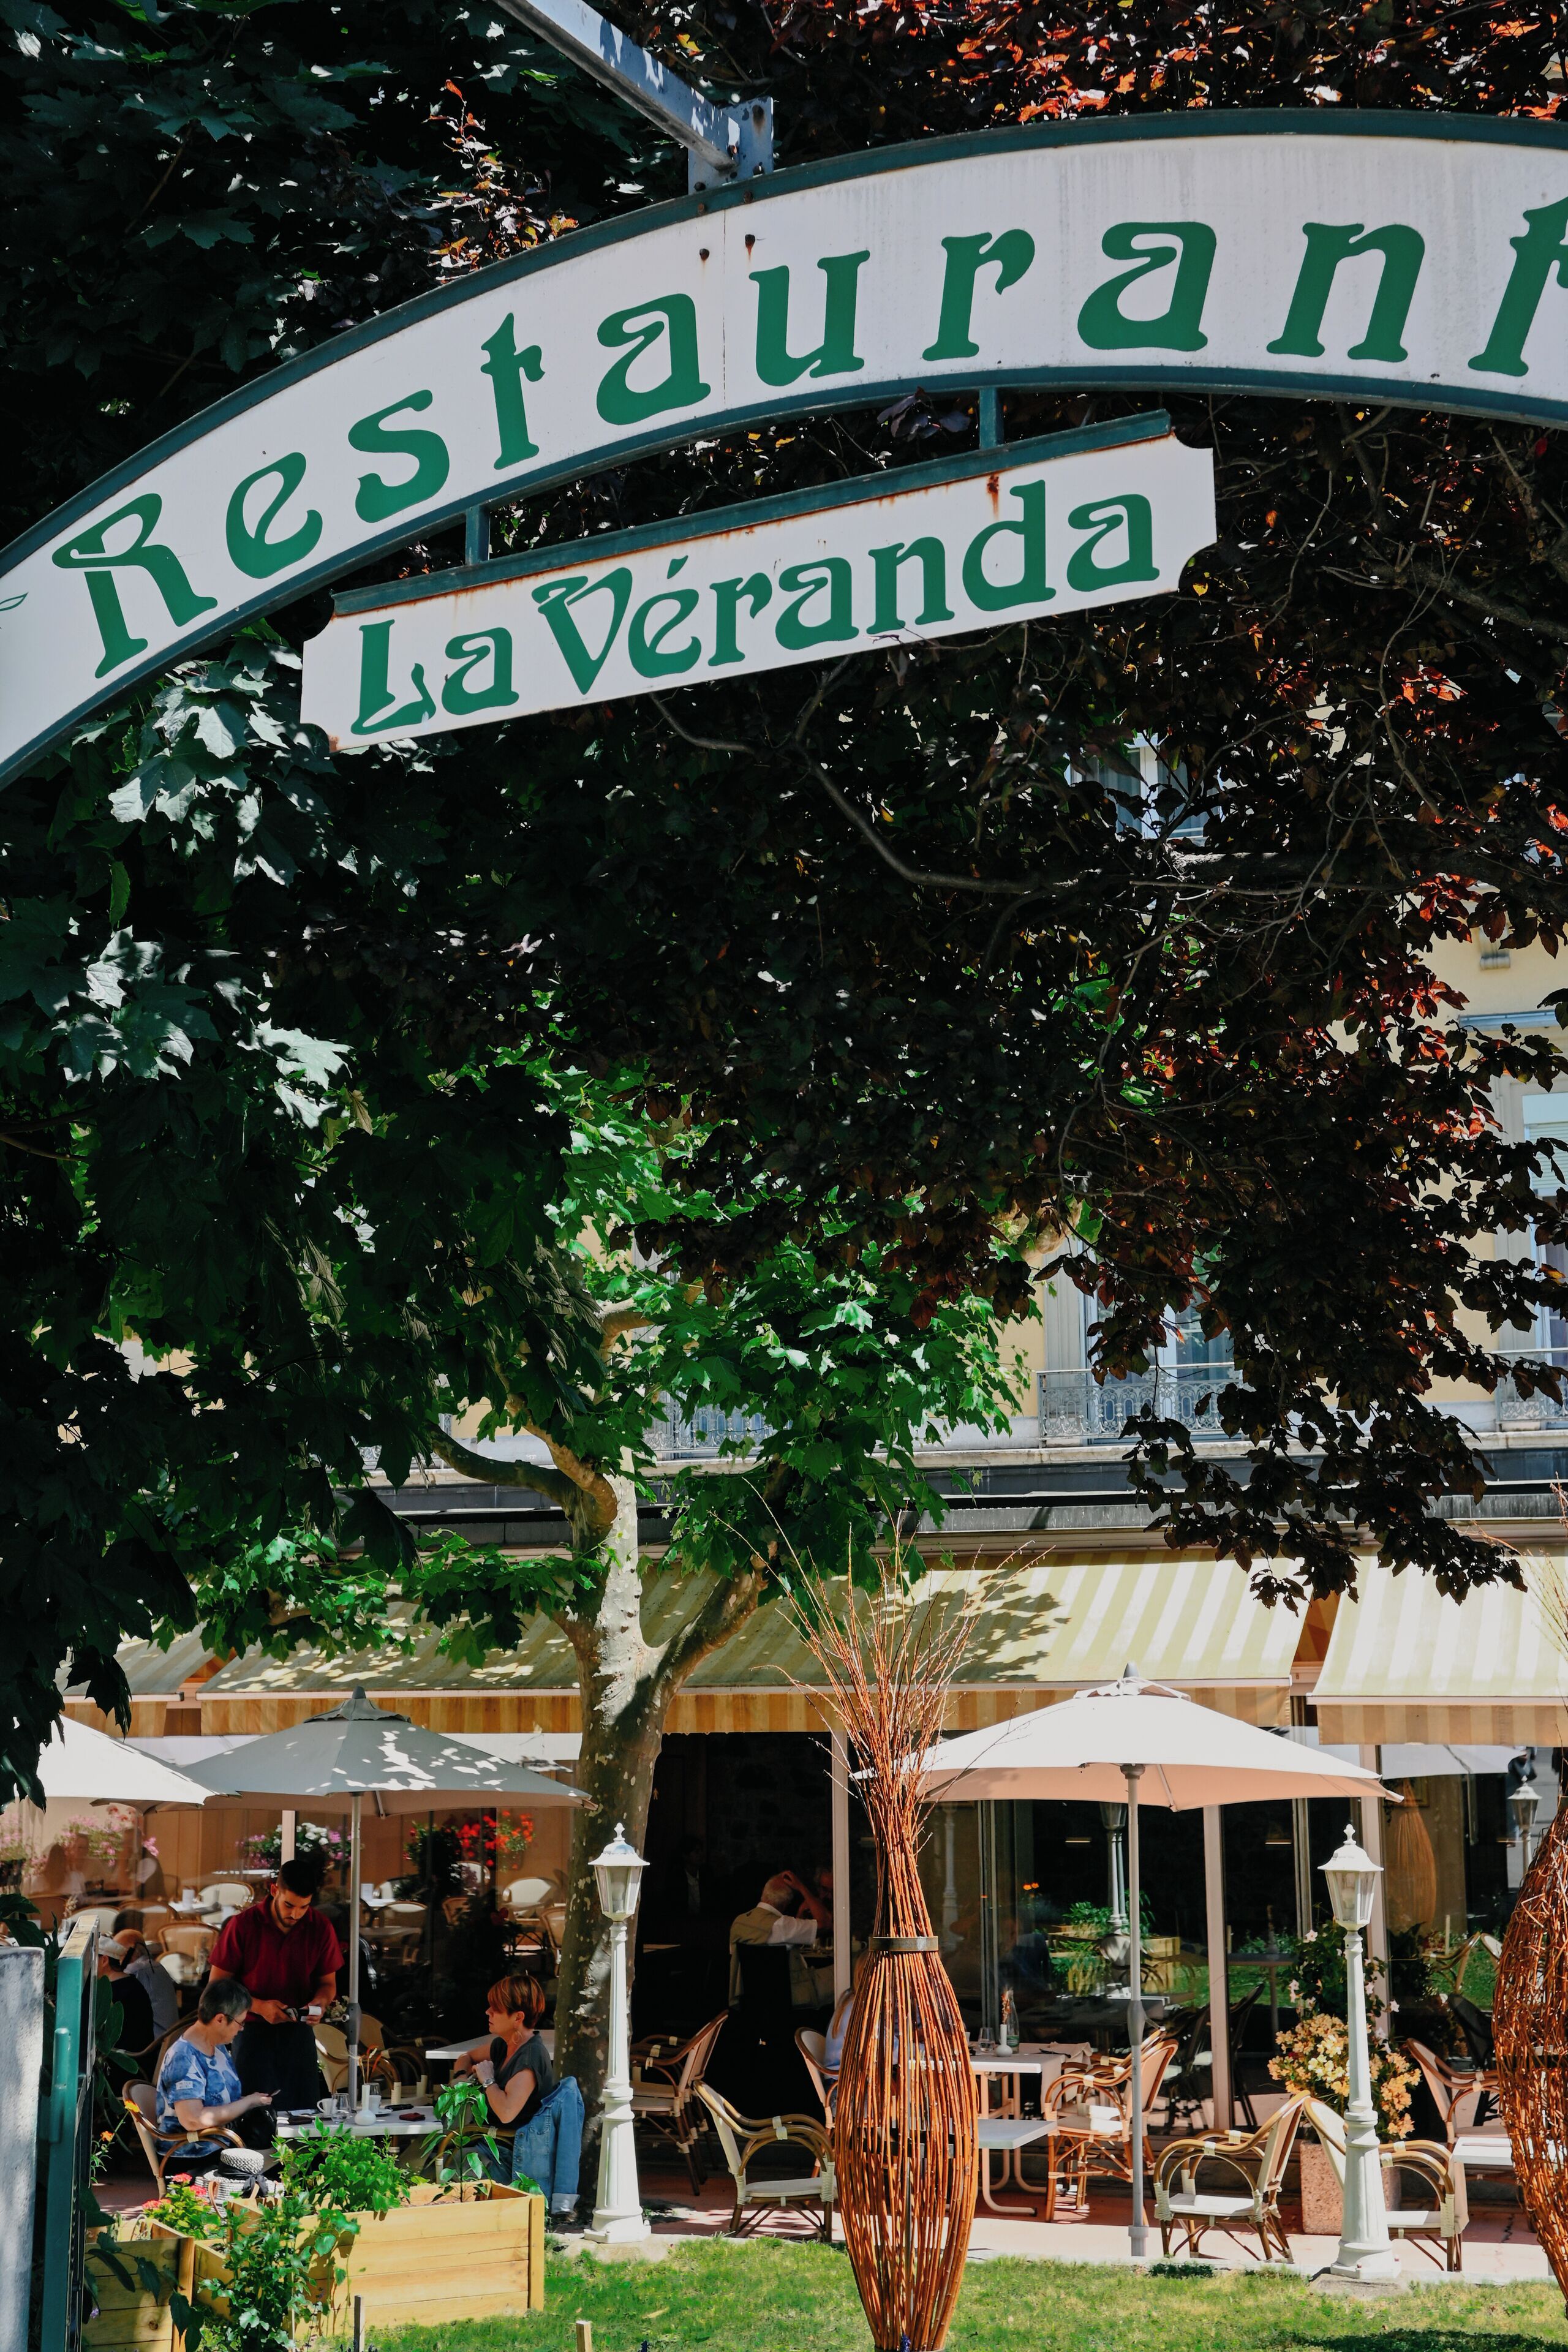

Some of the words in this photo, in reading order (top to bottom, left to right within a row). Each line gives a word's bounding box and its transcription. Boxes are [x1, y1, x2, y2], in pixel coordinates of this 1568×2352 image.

[52, 198, 1568, 678] Restaurant
[351, 619, 519, 735] La
[532, 479, 1160, 694] Véranda
